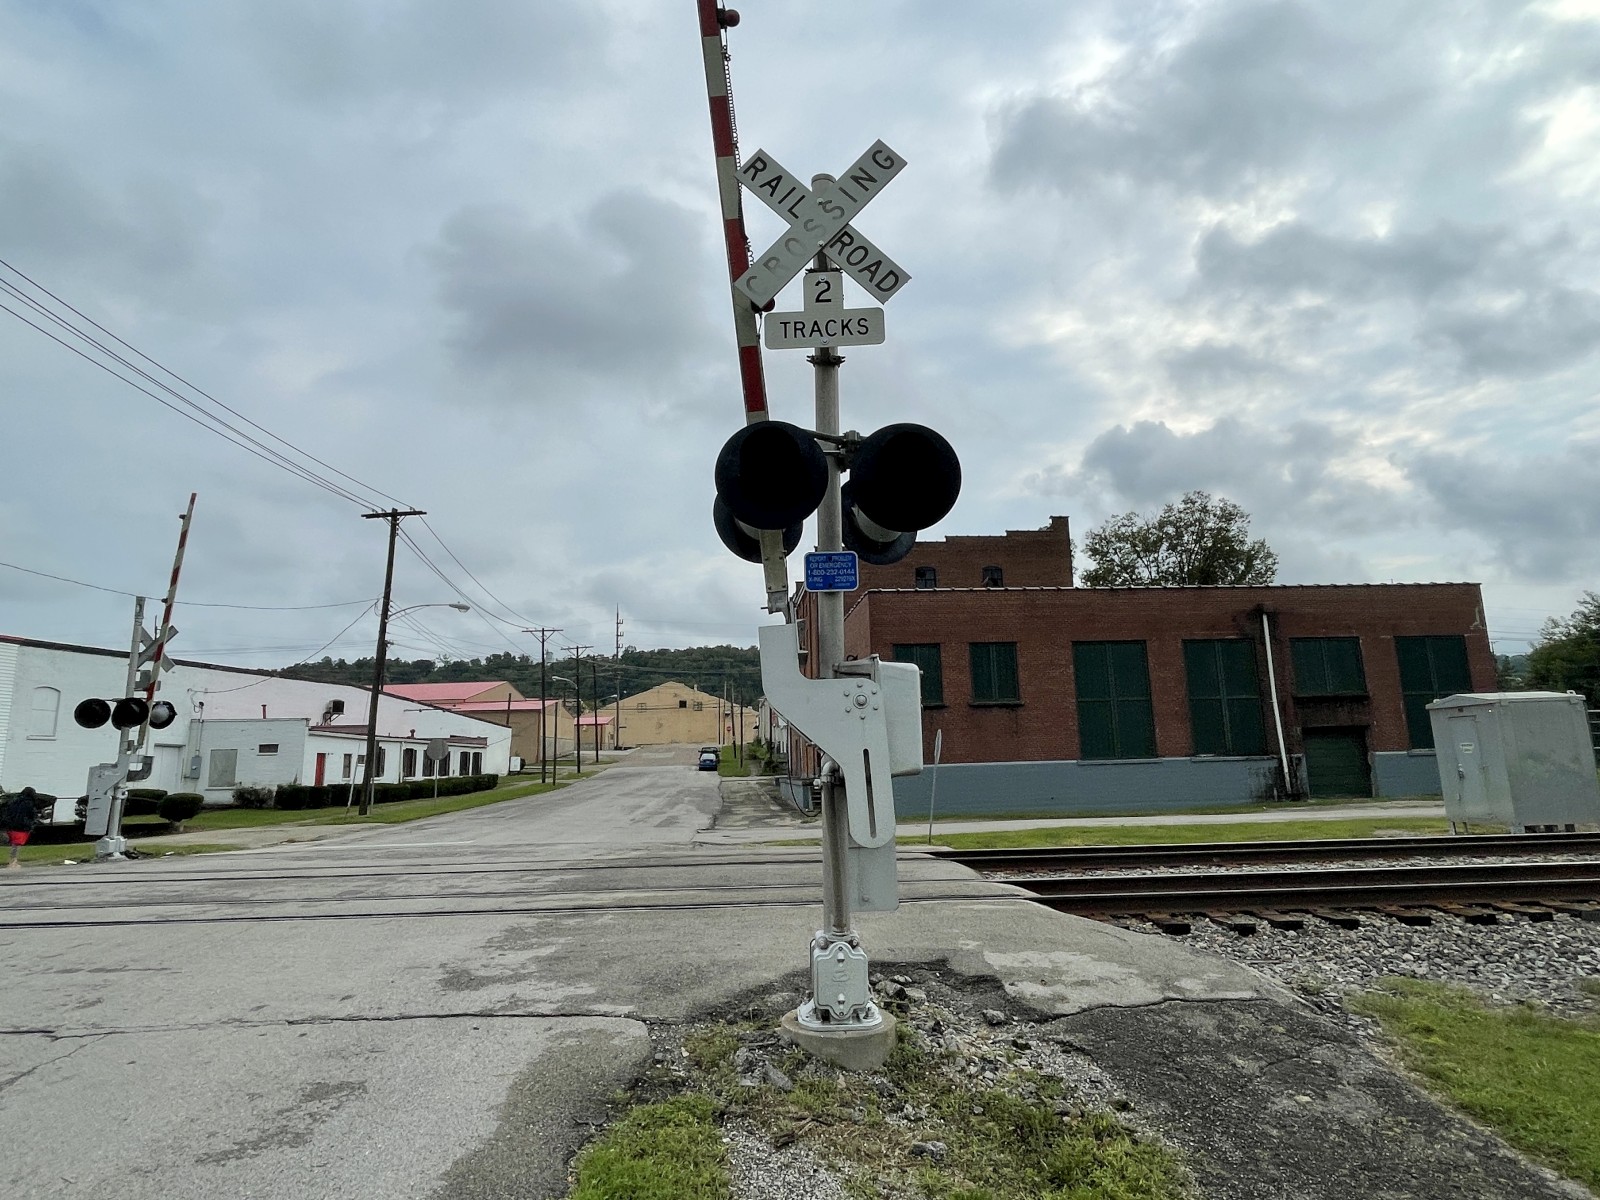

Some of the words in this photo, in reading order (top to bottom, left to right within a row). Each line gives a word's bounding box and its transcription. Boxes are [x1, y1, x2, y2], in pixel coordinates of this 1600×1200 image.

[743, 156, 806, 219] RAIL
[829, 230, 899, 293] ROAD
[746, 150, 895, 296] CROSSING
[779, 317, 869, 339] TRACKS
[814, 280, 832, 303] 2
